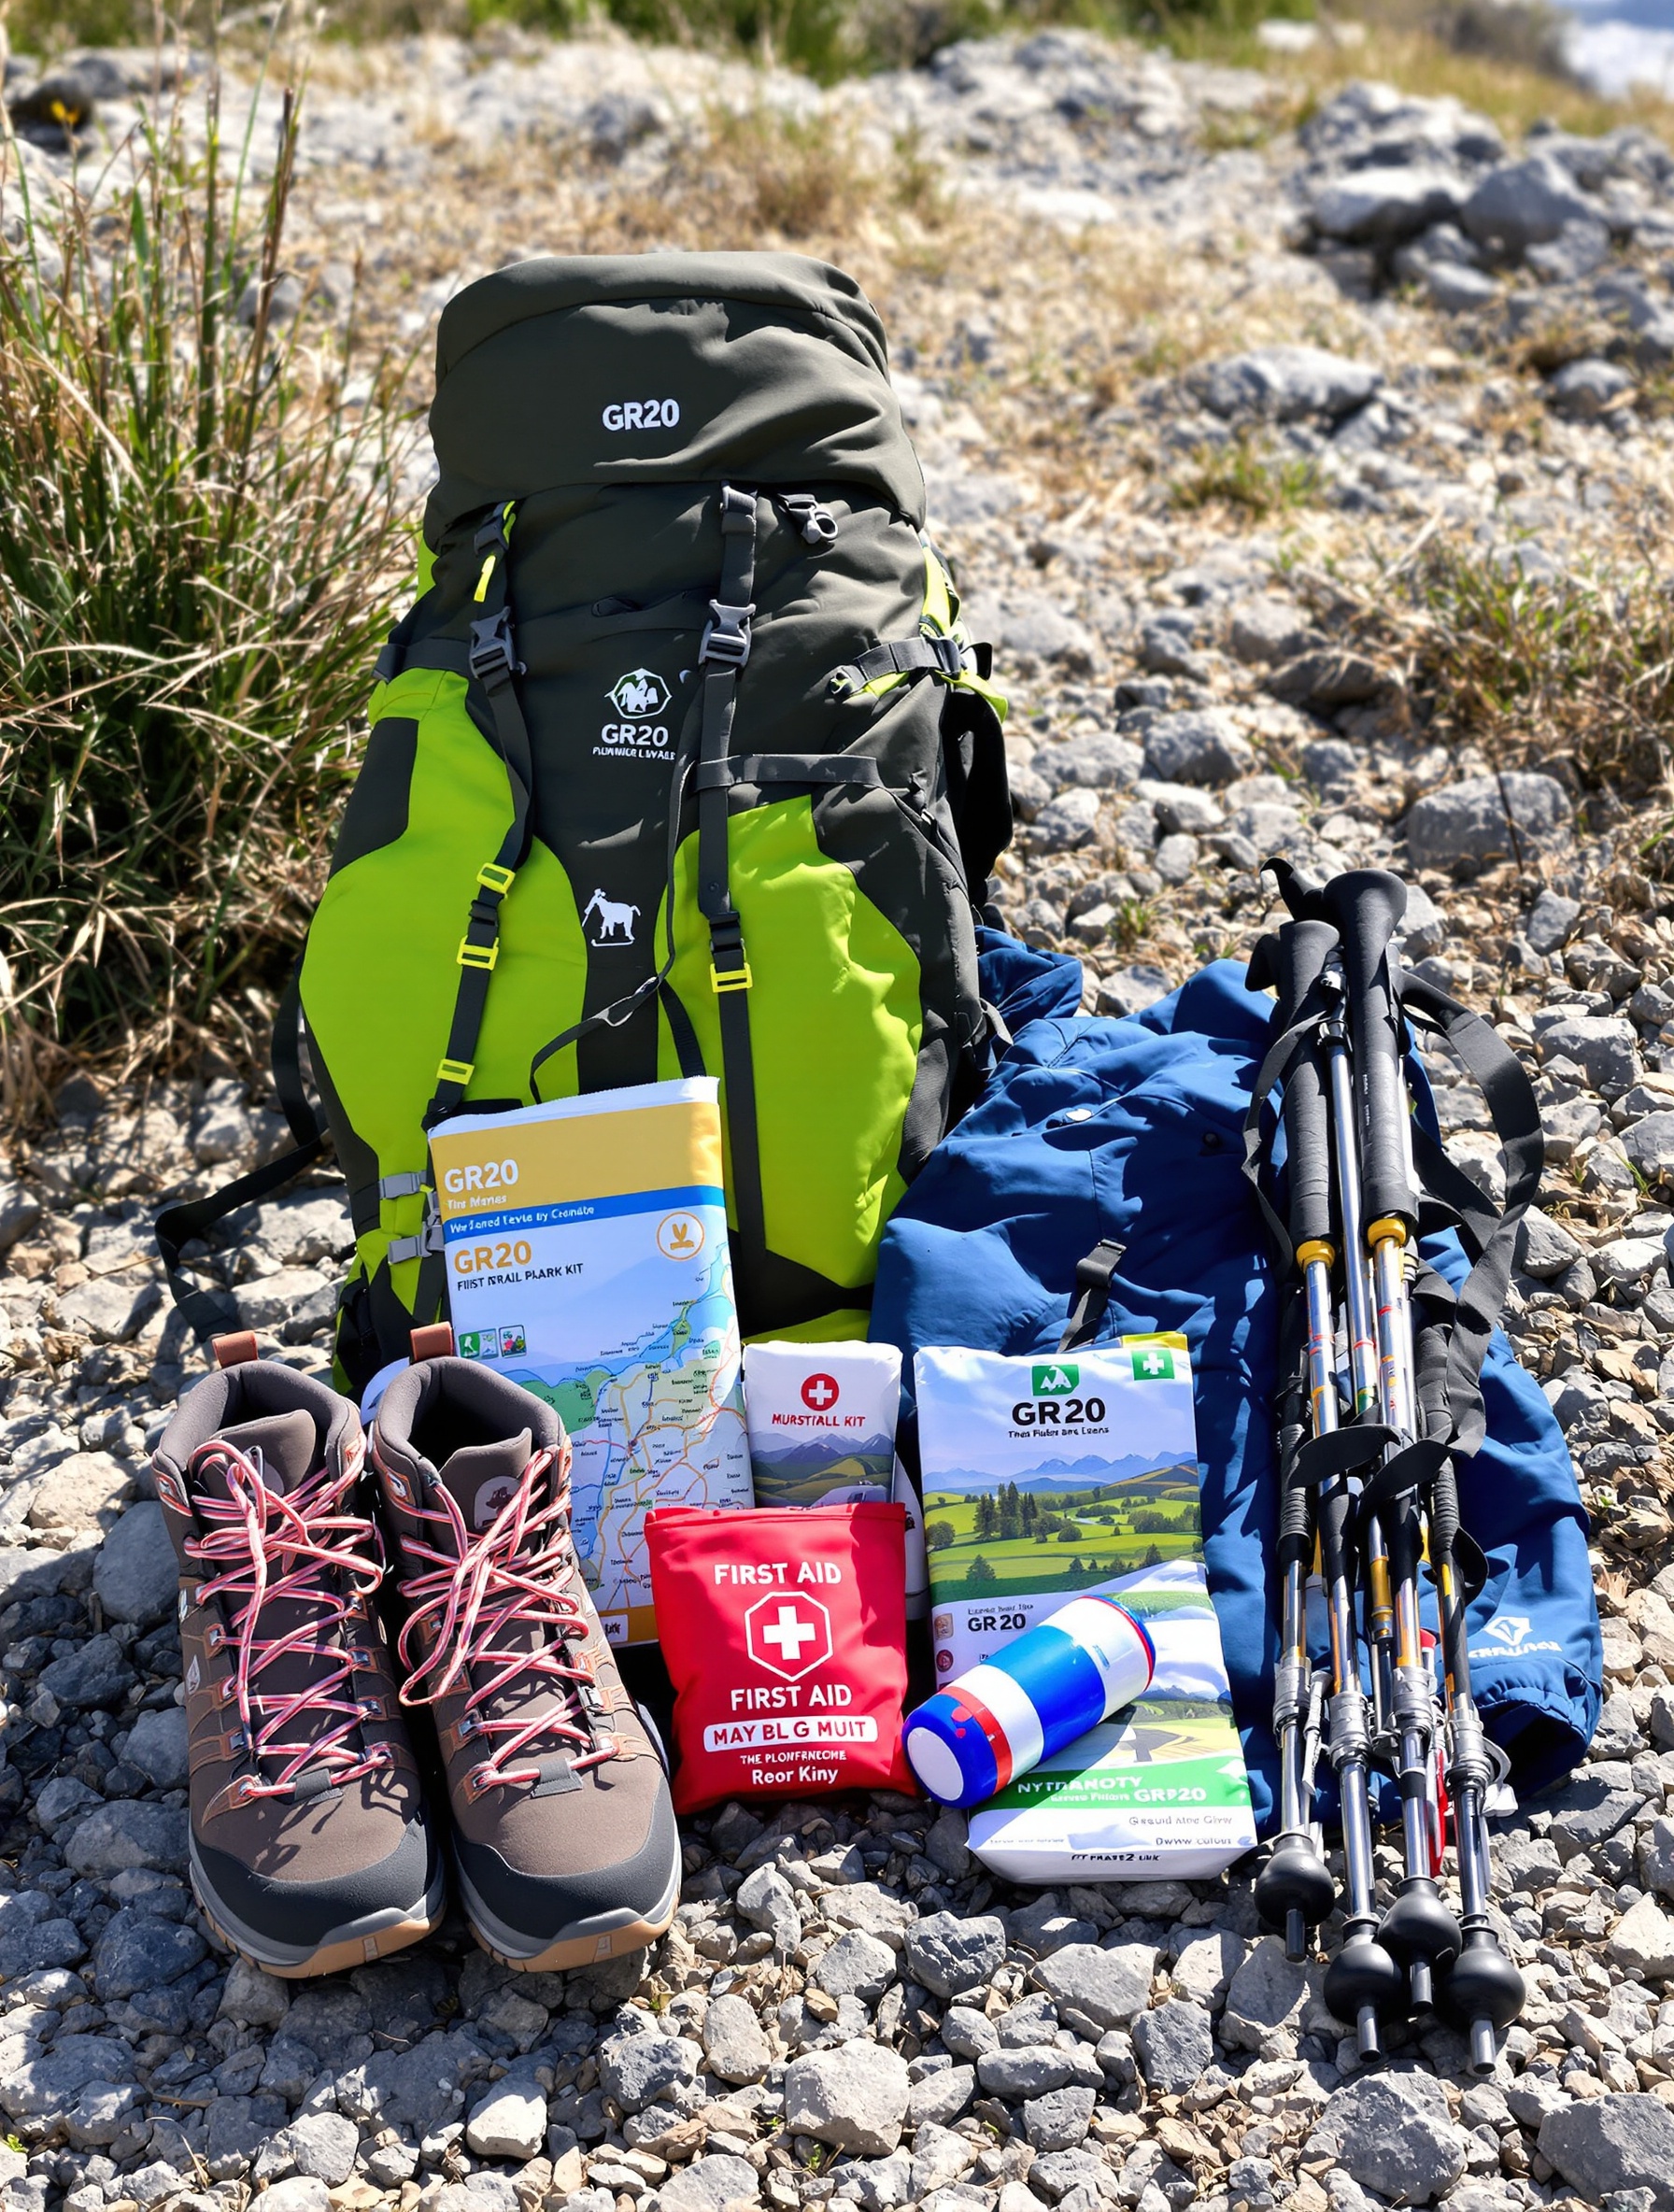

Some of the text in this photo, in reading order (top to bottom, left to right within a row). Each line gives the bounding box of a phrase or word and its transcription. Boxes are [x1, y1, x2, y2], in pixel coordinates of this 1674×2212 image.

[602, 399, 680, 432] GR20
[601, 723, 669, 747] GR20
[444, 1158, 519, 1194] GR20
[454, 1240, 532, 1275] GR20
[565, 1262, 584, 1275] KIT
[844, 1415, 866, 1427] KIT
[714, 1562, 842, 1585] FIRST AID
[730, 1684, 852, 1711] FIRST AID
[713, 1725, 759, 1746] MAY
[816, 1721, 866, 1737] MUIT
[799, 1765, 839, 1785] Kiny
